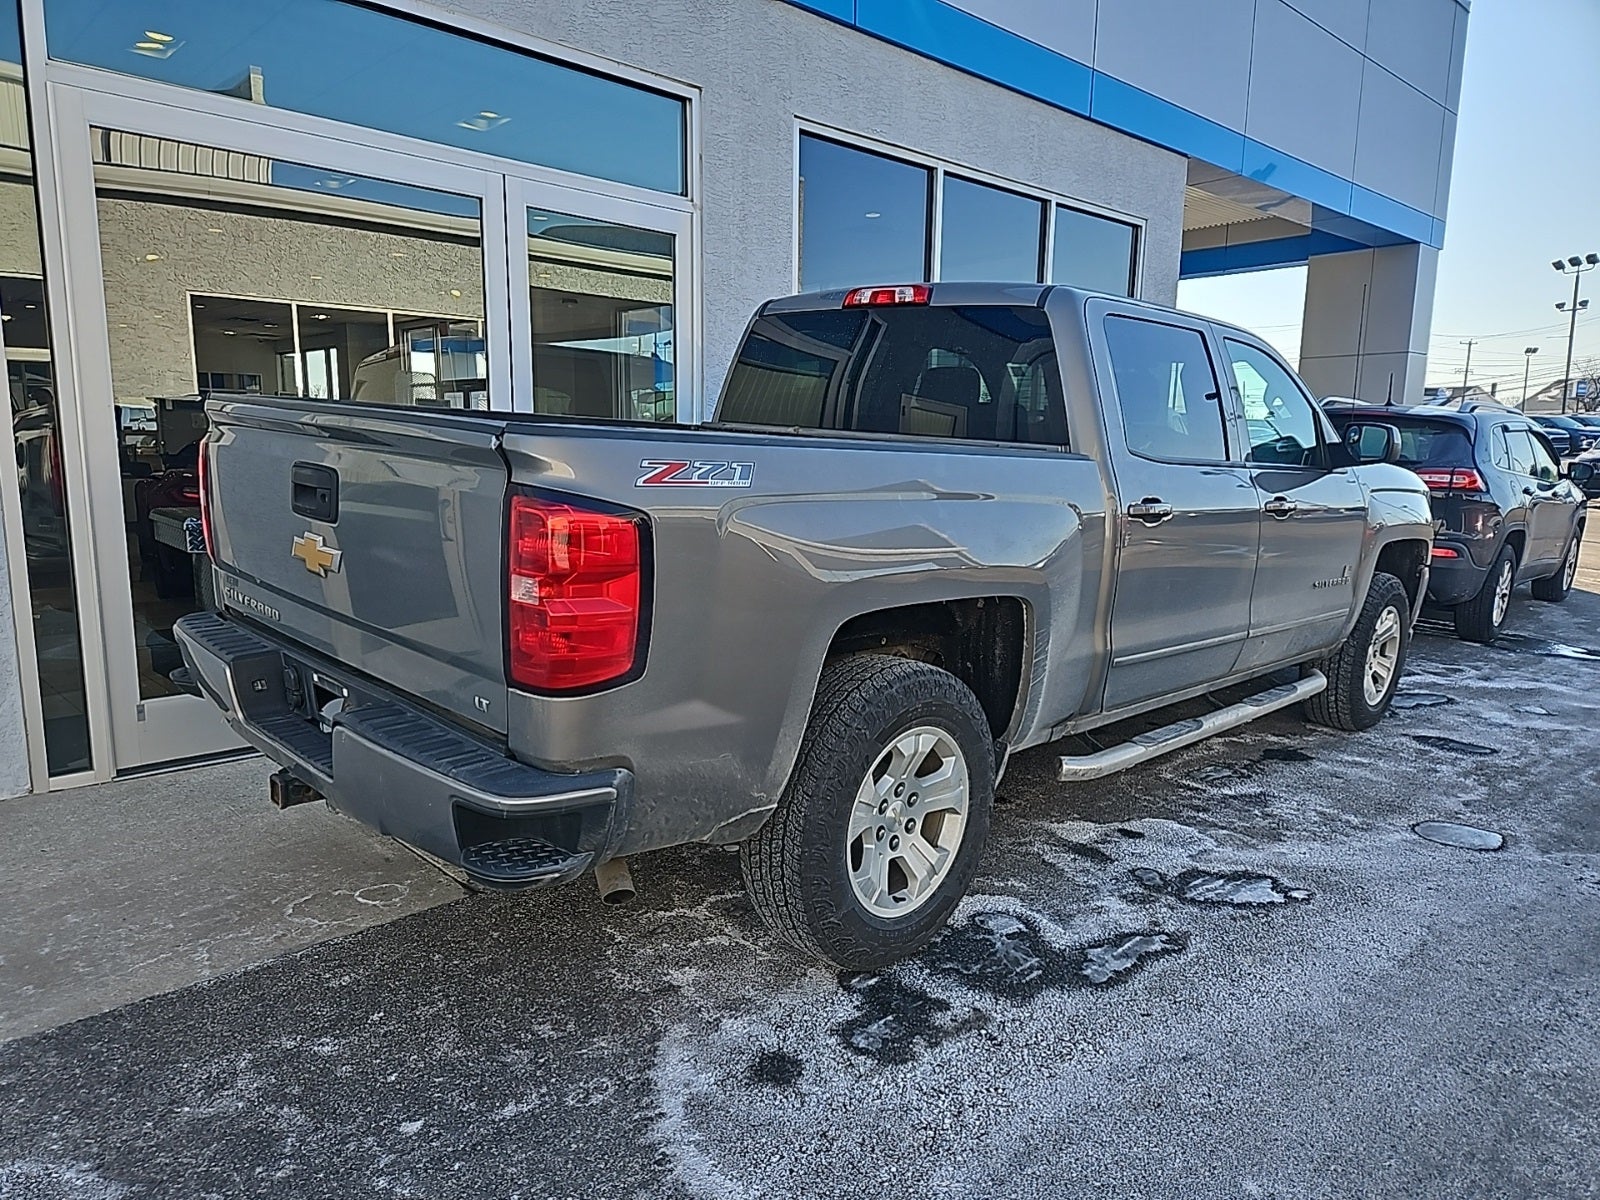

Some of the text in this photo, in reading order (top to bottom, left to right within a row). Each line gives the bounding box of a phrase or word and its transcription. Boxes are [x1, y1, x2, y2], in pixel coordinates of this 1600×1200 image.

[634, 459, 756, 488] Z71
[224, 586, 281, 621] SILVERADO
[474, 695, 491, 713] LT
